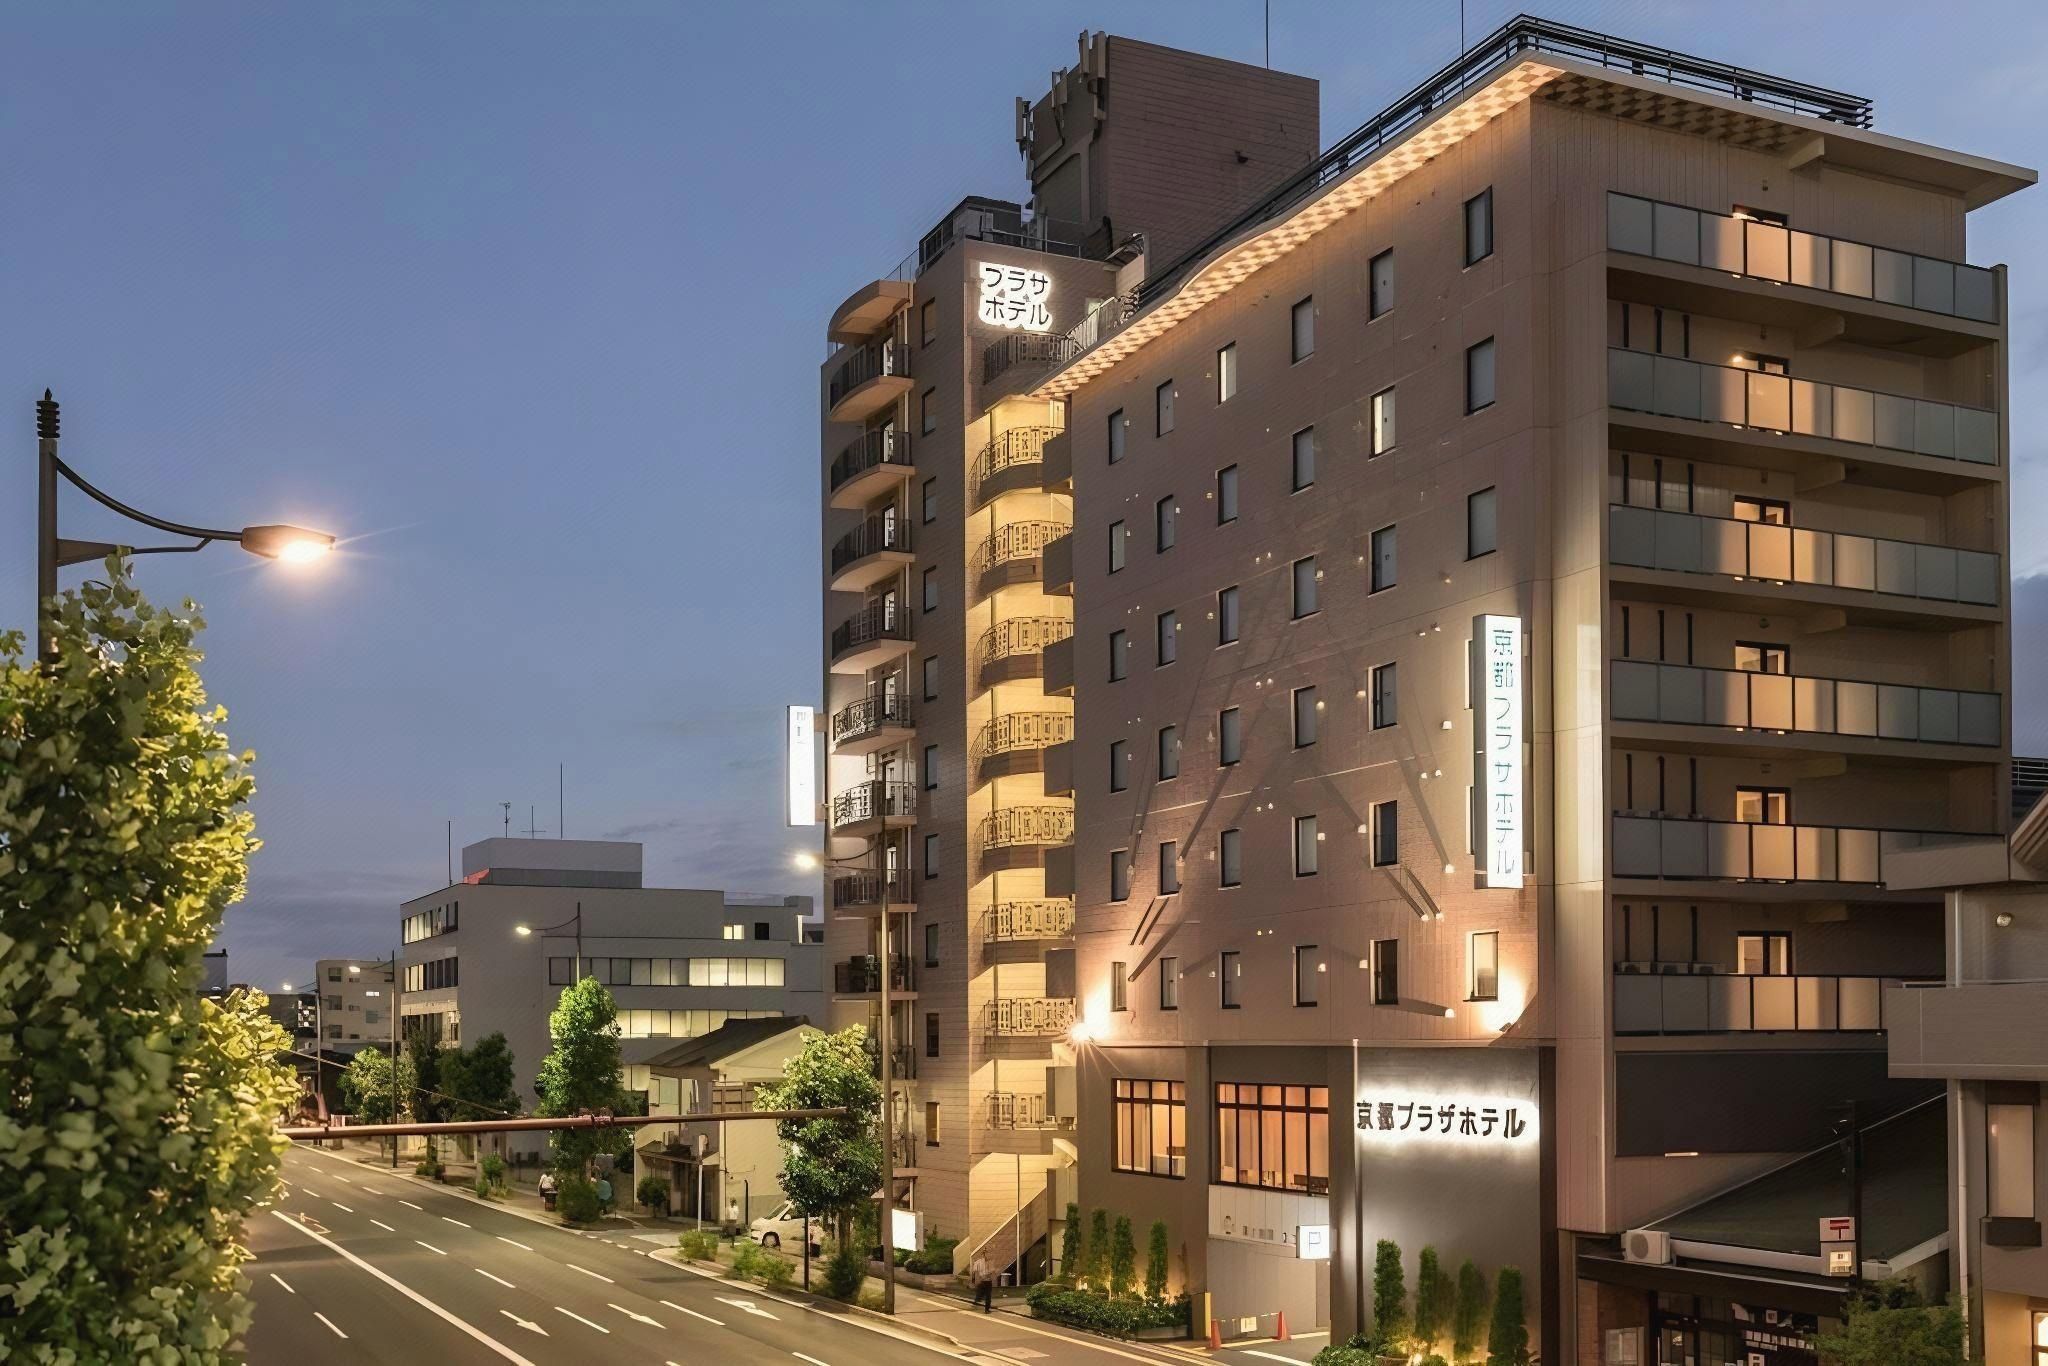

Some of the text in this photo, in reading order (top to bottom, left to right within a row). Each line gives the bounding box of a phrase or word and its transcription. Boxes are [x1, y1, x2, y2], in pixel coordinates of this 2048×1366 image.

[985, 296, 1050, 326] ホテル
[1308, 1231, 1322, 1254] P
